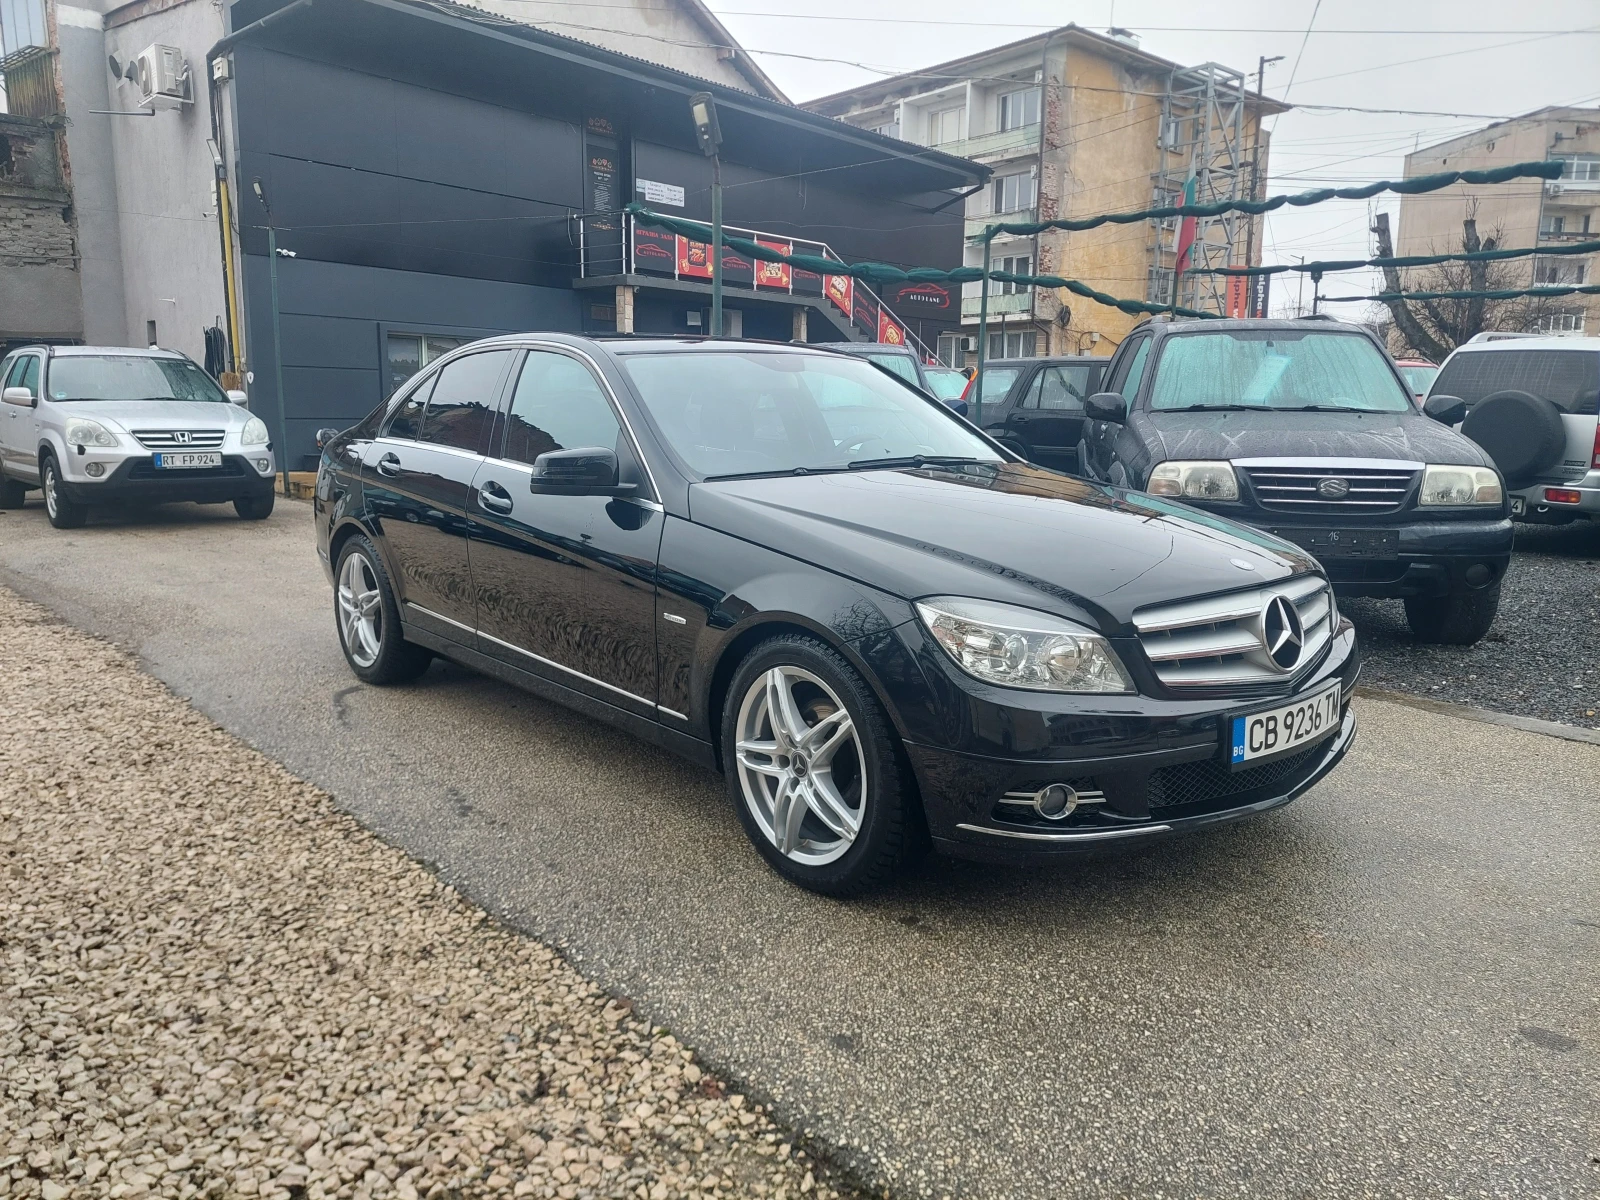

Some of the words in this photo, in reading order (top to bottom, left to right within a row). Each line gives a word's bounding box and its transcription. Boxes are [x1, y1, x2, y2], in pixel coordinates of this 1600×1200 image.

[910, 294, 940, 303] AUTOLAND
[162, 455, 175, 466] RT
[182, 455, 195, 465] FP
[197, 455, 214, 465] 924
[1249, 716, 1278, 753] CB
[1283, 698, 1322, 745] 9236
[1325, 687, 1341, 726] TM
[1232, 744, 1244, 757] BG
